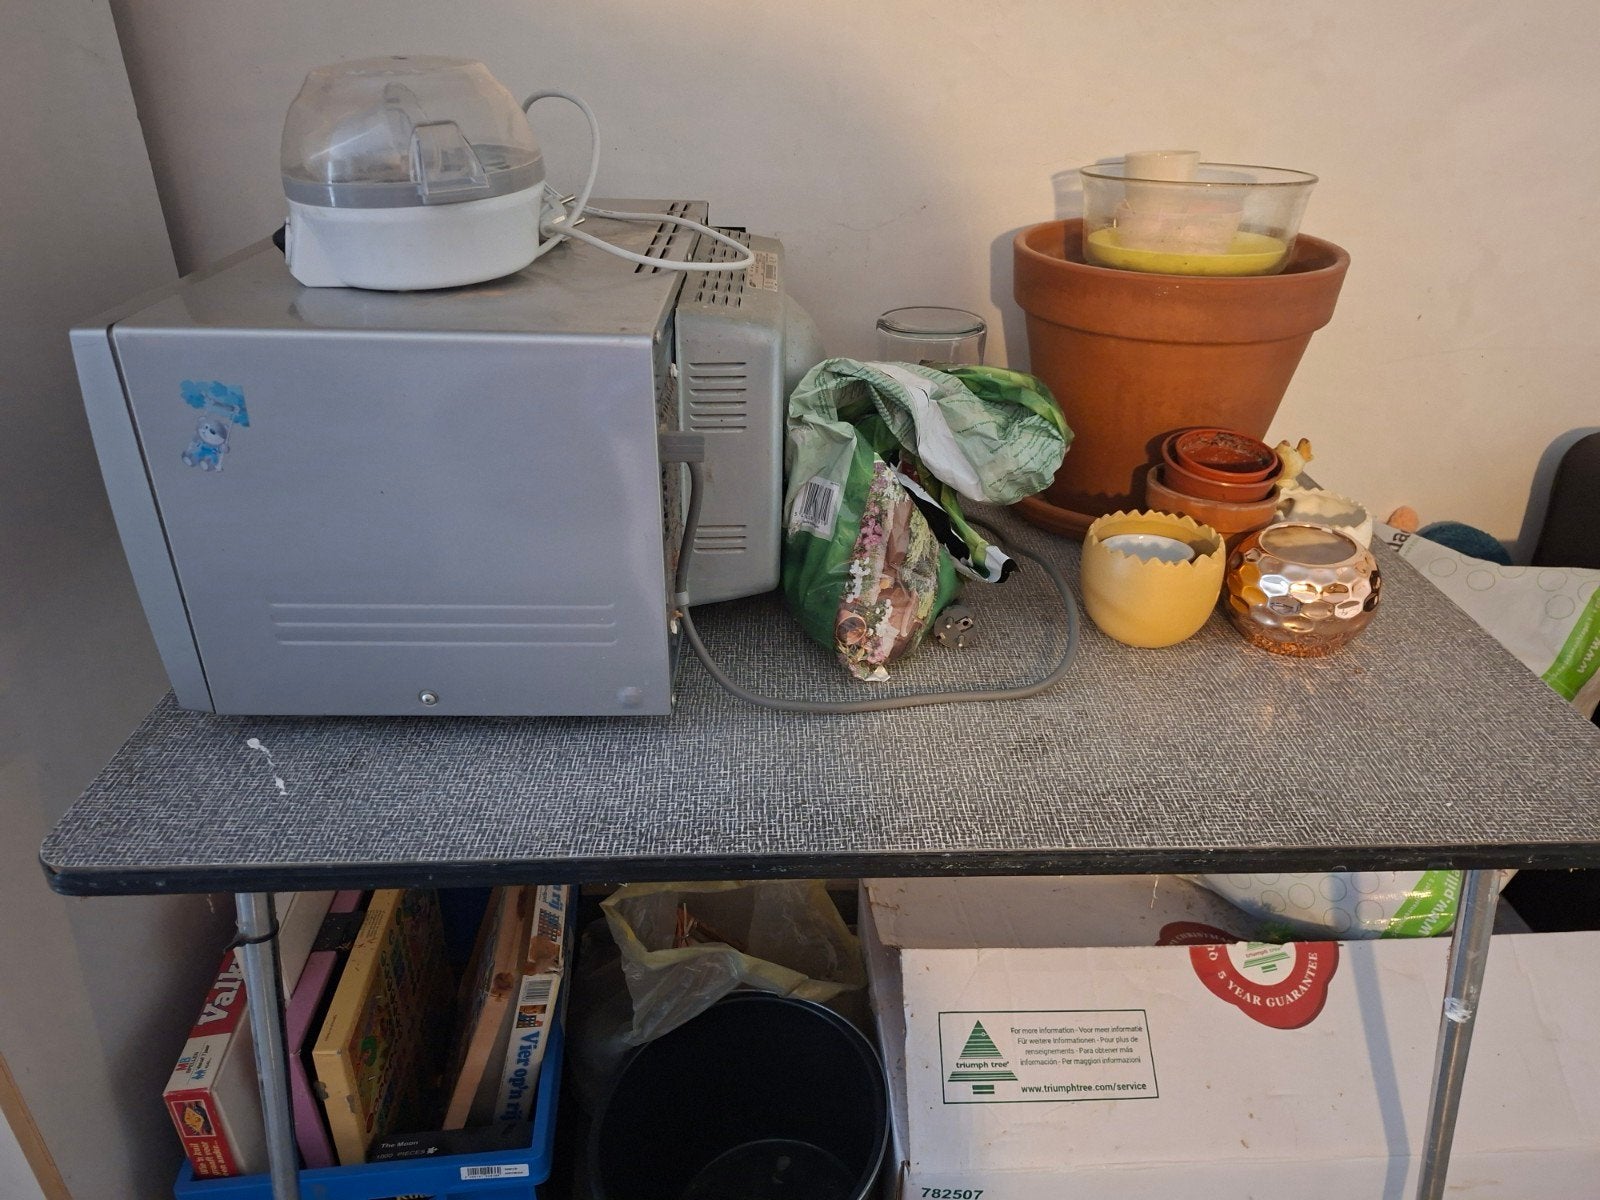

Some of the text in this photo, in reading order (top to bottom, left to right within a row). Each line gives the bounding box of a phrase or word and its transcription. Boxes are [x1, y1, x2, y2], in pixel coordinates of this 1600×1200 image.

[1217, 951, 1319, 1008] 5 YEAR GUARANTEE
[197, 956, 243, 1026] Valk
[1010, 1027, 1020, 1035] For
[1040, 1026, 1075, 1034] information
[1079, 1025, 1093, 1034] Voor
[1111, 1025, 1143, 1033] informatie
[1017, 1037, 1028, 1045] Für
[1099, 1036, 1115, 1044] Pour
[1115, 1036, 1131, 1044] plus
[516, 1030, 540, 1067] Vier
[1025, 1047, 1075, 1056] renseignements
[1079, 1047, 1094, 1055] Para
[1095, 1046, 1118, 1054] obtener
[956, 1062, 988, 1070] triumph
[1061, 1058, 1073, 1066] Per
[1073, 1057, 1101, 1067] maggiori
[1102, 1056, 1141, 1065] informazioni
[1020, 1082, 1147, 1094] www.triumphtree.com/service
[396, 1140, 419, 1148] Moon
[921, 1187, 984, 1200] 782507
